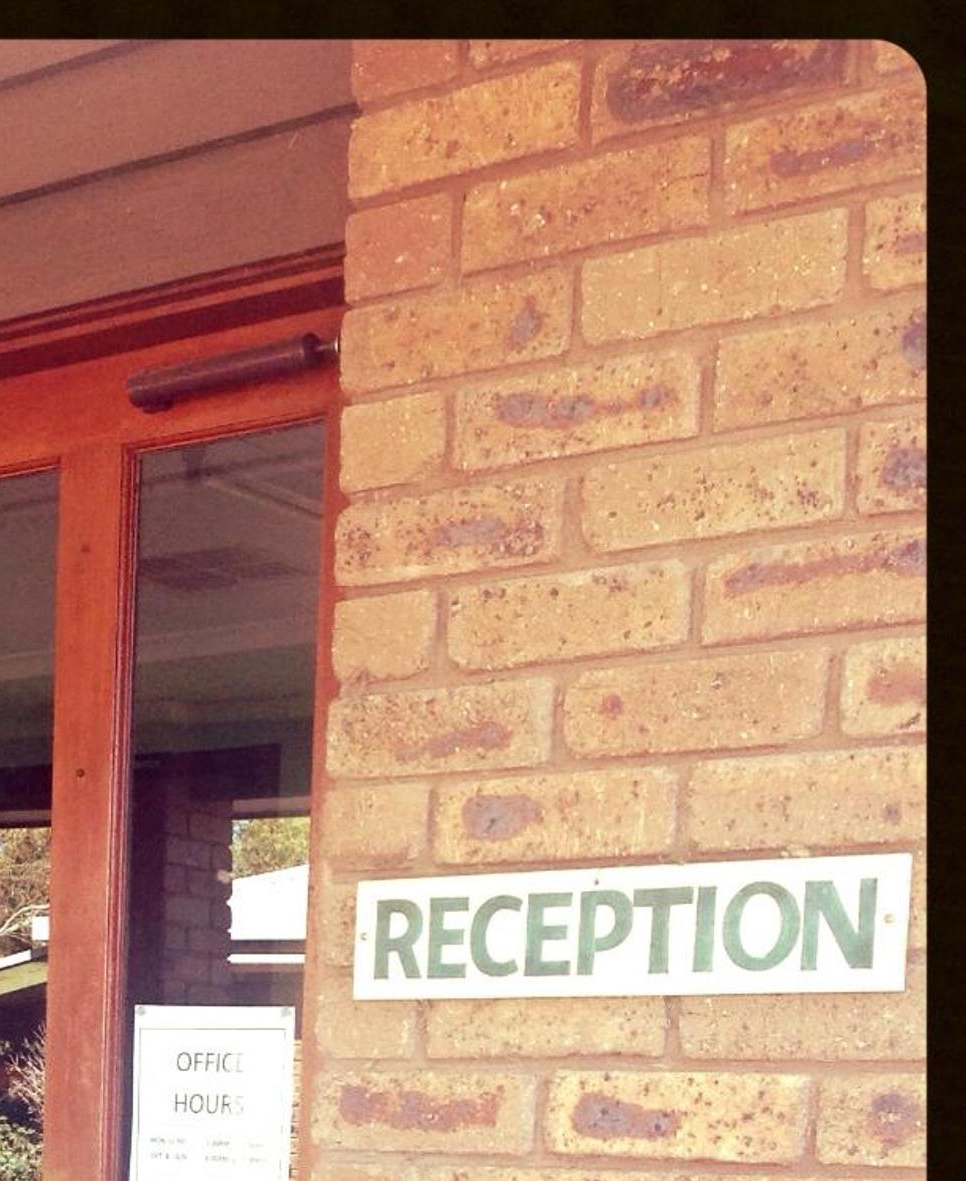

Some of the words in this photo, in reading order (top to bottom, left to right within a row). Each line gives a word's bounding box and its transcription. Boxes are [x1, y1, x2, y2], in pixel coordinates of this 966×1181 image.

[372, 876, 879, 981] RECEPTION
[175, 1051, 245, 1074] OFFICE
[173, 1092, 245, 1116] HOURS
